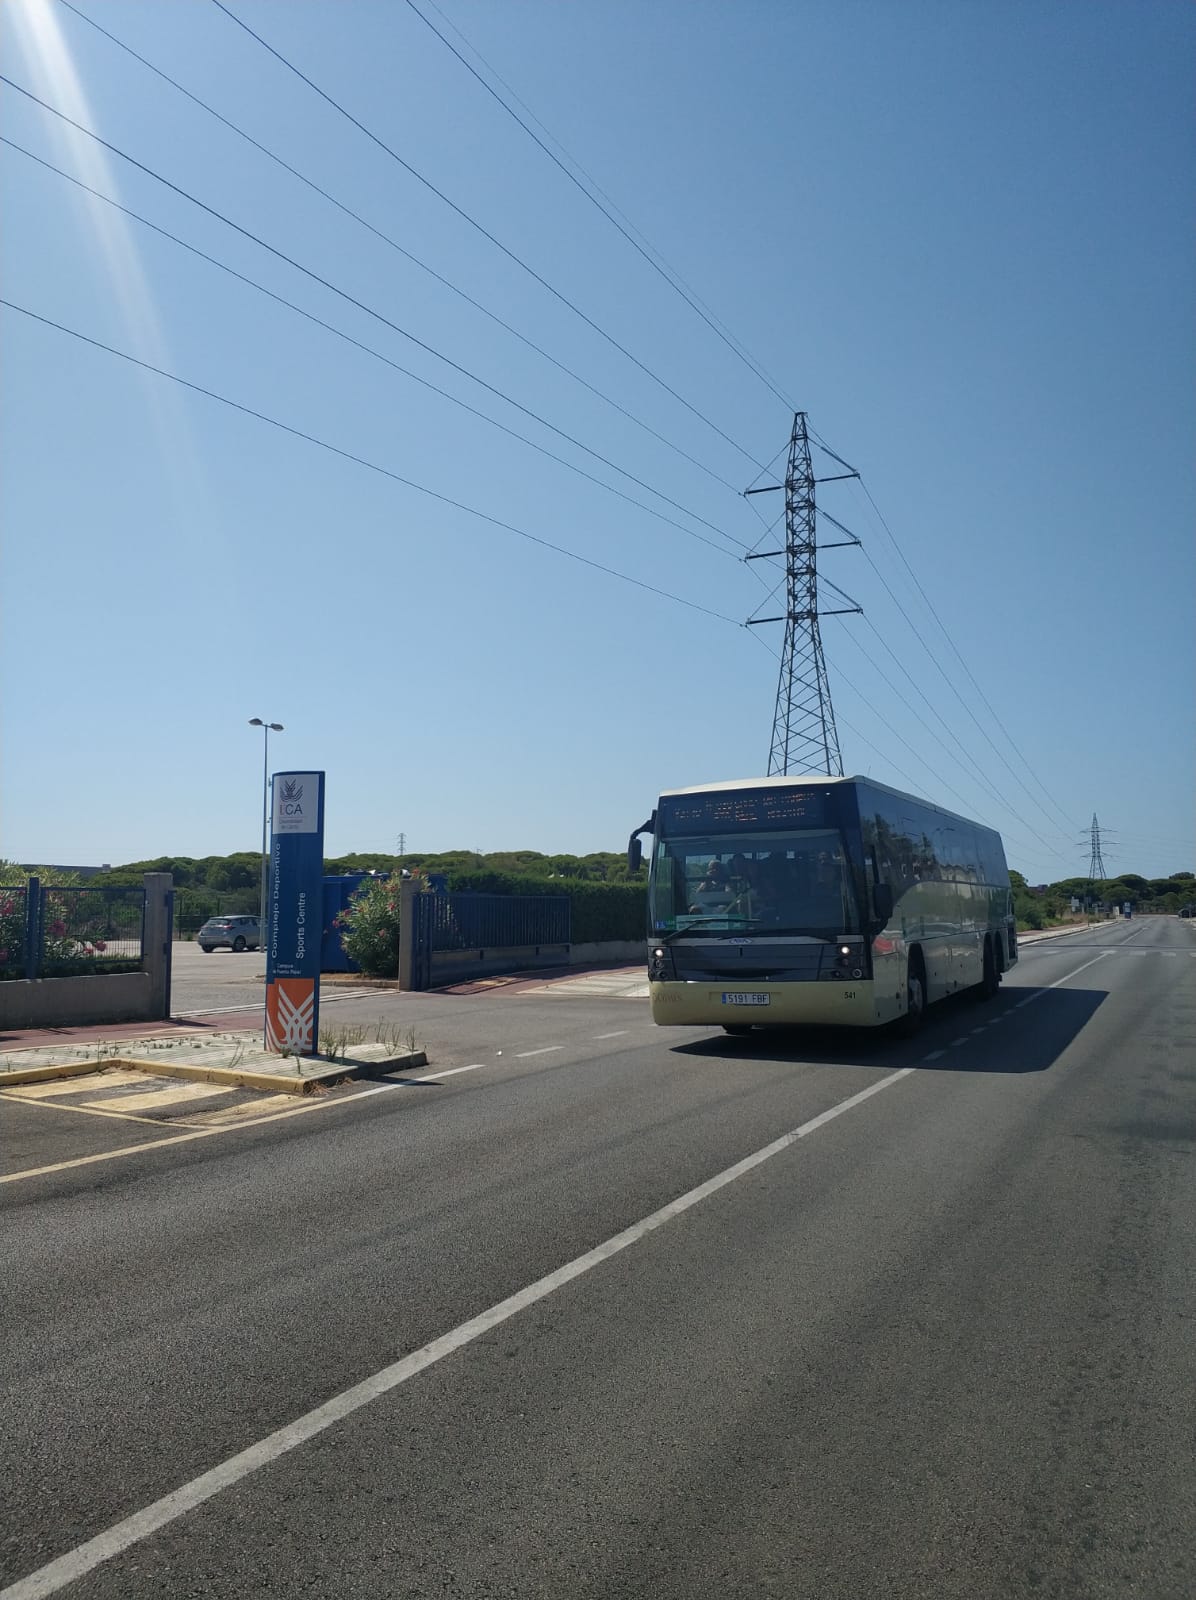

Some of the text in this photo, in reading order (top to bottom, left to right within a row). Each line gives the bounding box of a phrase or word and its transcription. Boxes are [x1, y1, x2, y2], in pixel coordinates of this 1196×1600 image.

[273, 843, 281, 899] Deportivo
[271, 903, 280, 959] Complejo
[296, 892, 306, 959] Sports Centre
[727, 993, 769, 1004] 5191 FBF
[844, 991, 856, 1000] 541
